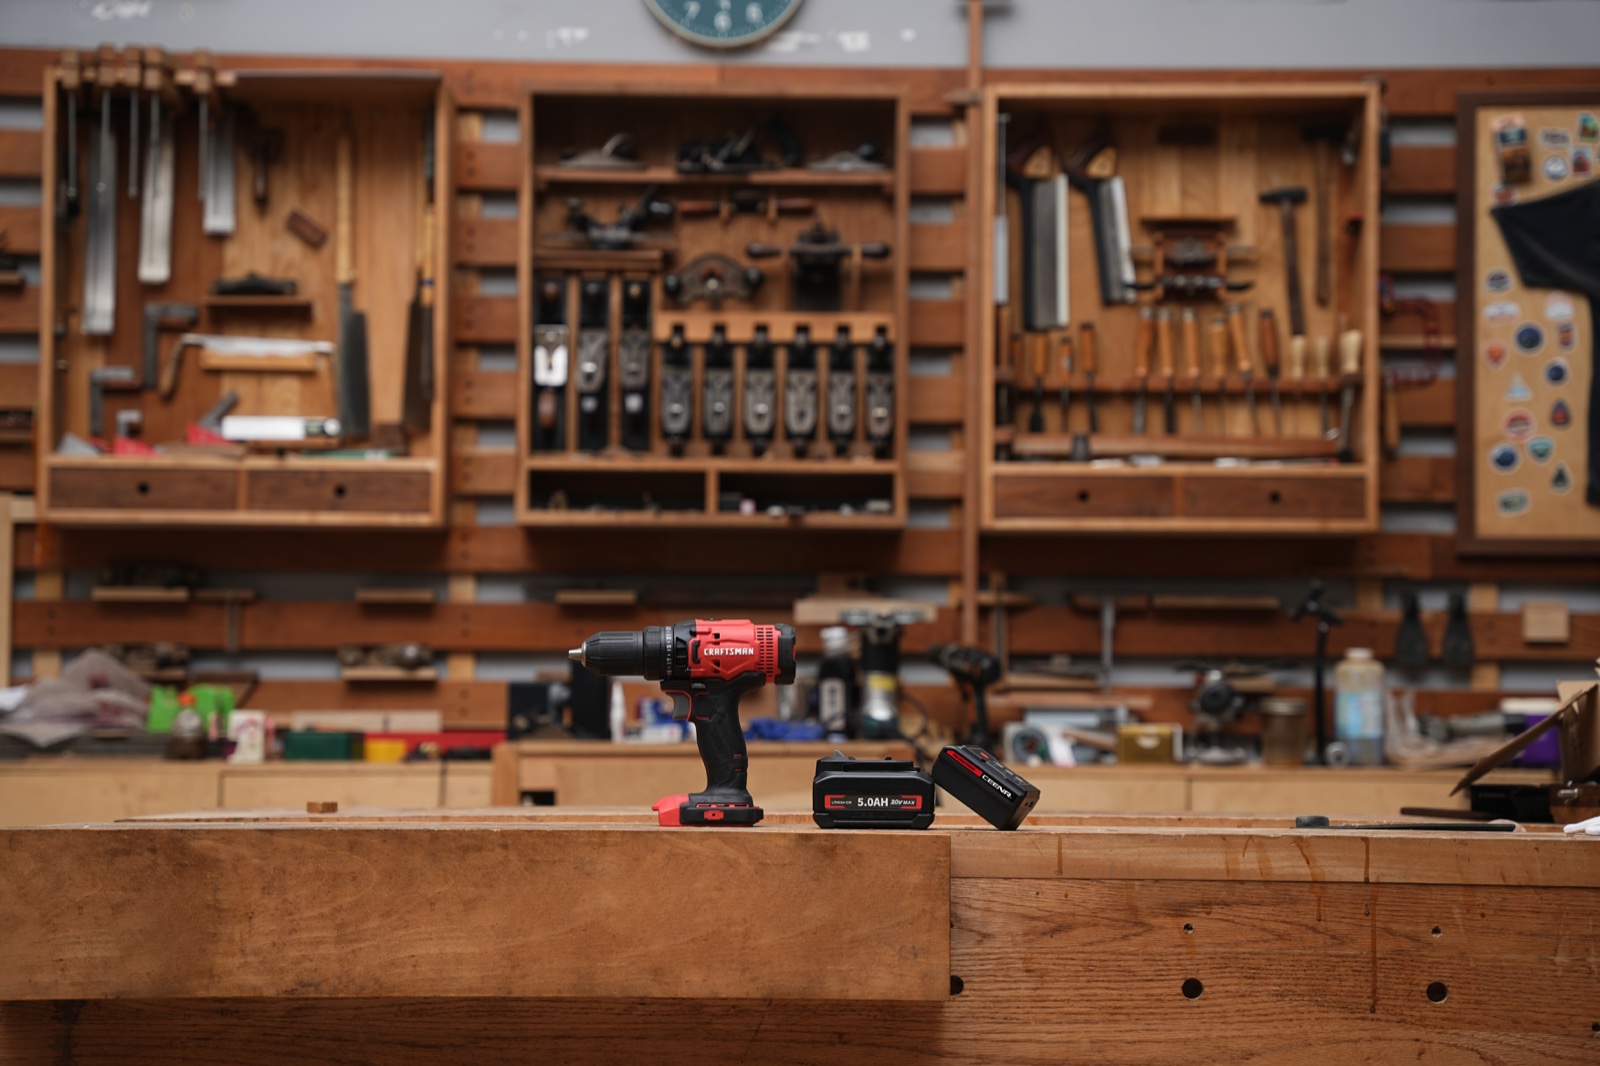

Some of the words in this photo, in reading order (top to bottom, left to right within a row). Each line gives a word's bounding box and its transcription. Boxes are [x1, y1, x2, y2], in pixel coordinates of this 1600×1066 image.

[703, 647, 754, 656] CRAFTSMAN
[981, 774, 1012, 799] CEENR
[857, 797, 889, 807] 5.0AH
